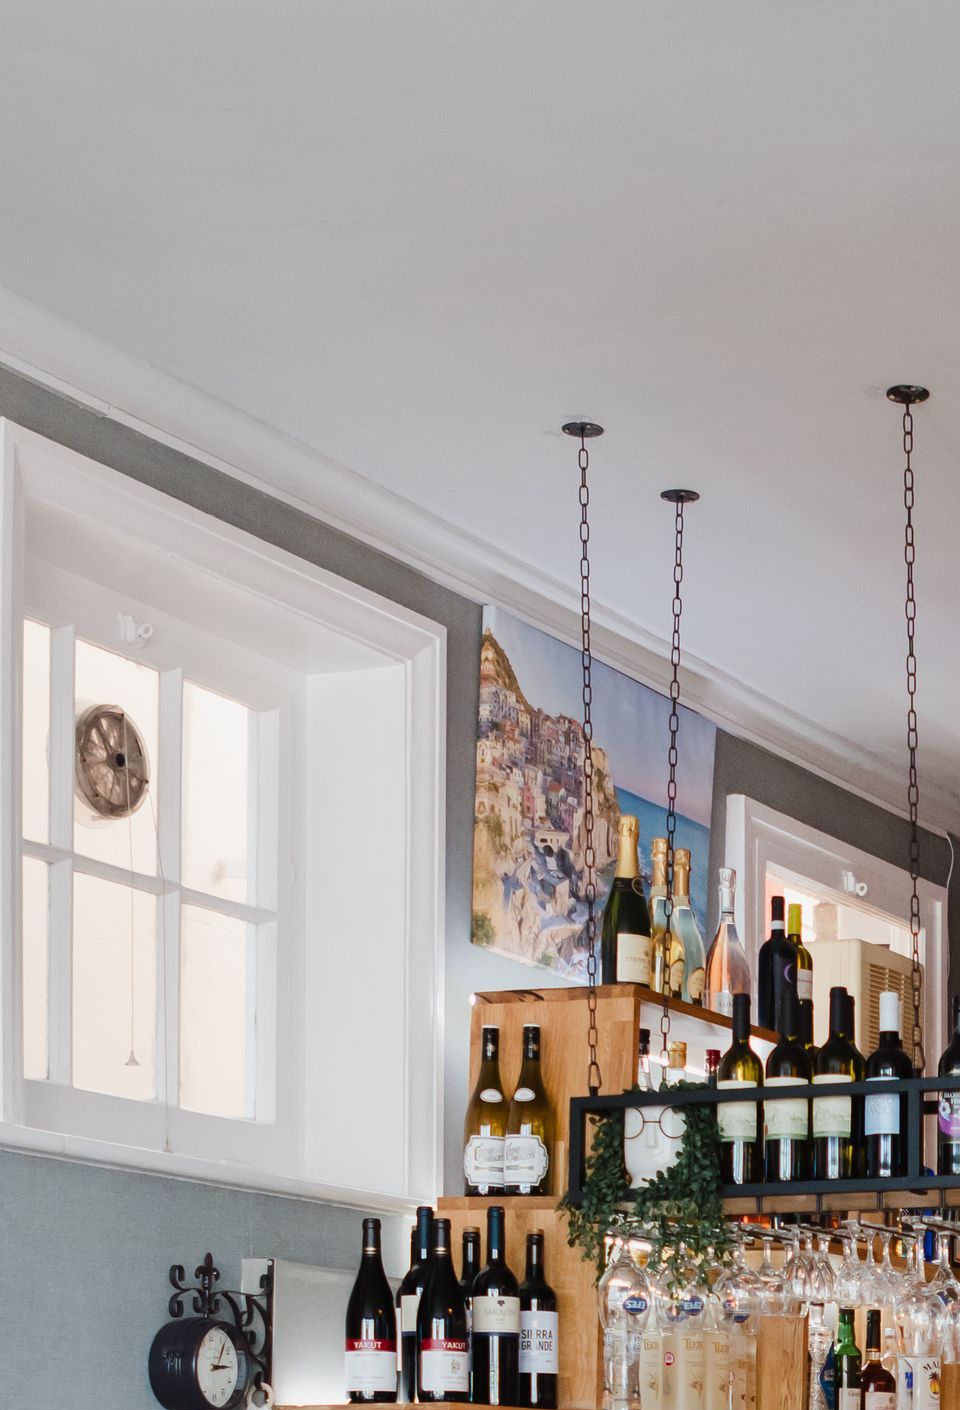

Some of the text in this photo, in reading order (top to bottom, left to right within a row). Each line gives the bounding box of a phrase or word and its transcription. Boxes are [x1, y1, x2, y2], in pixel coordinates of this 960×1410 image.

[353, 1341, 382, 1350] YAKUT
[441, 1341, 467, 1350] YAKUT
[521, 1340, 553, 1352] GRNDE
